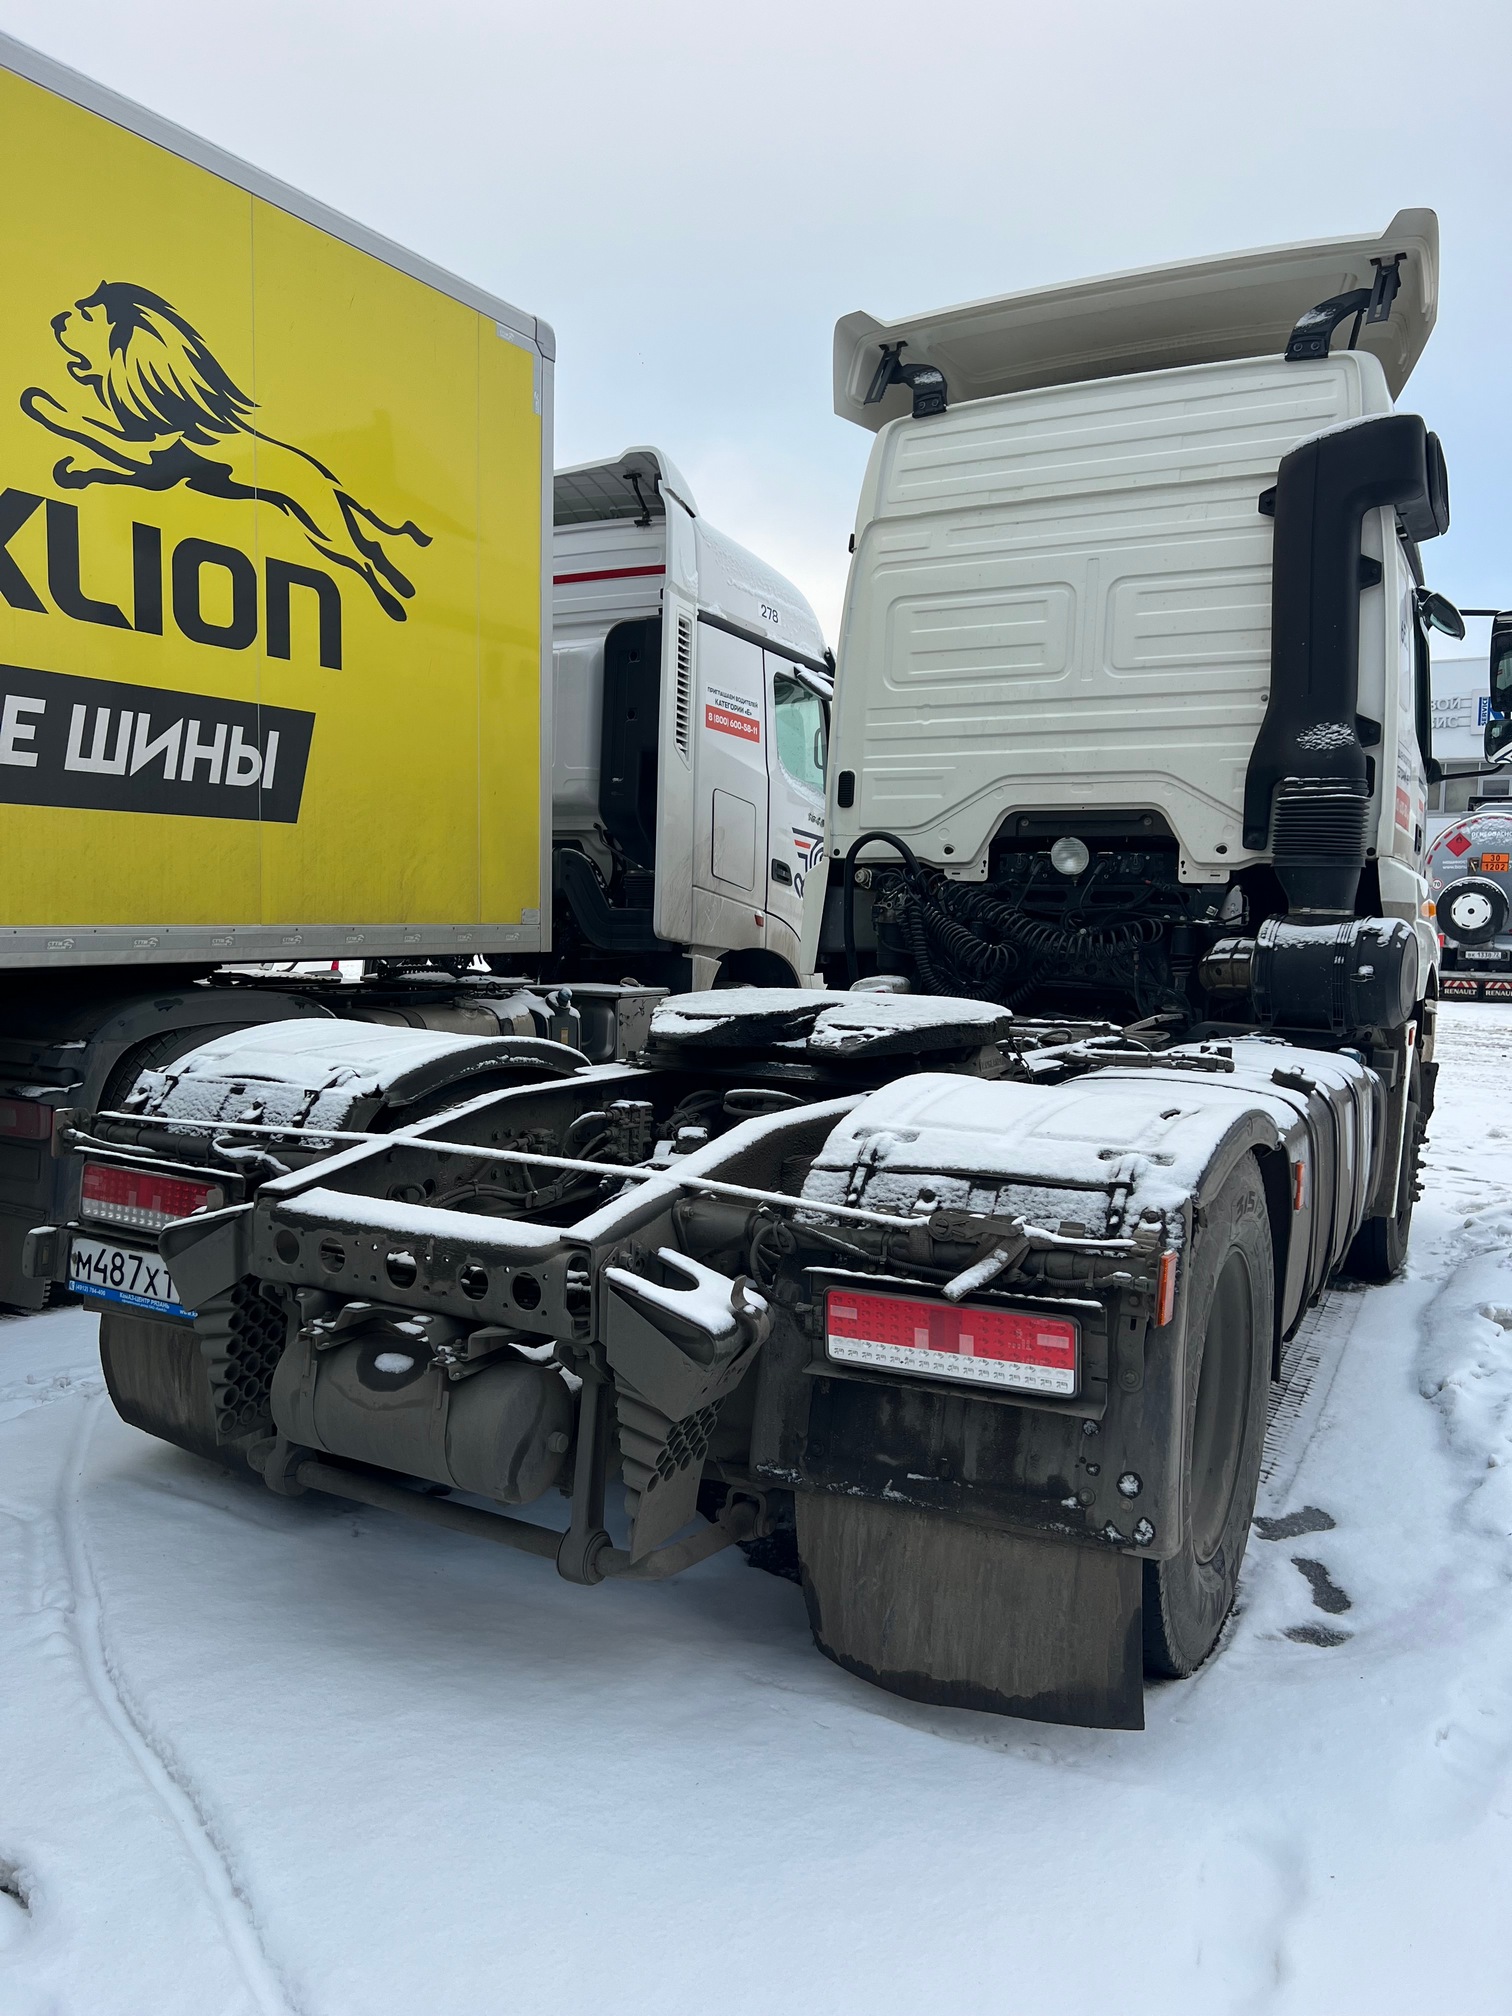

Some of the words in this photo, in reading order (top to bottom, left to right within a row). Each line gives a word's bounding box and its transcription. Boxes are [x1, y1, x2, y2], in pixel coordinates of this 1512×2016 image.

[761, 604, 779, 623] 278
[714, 698, 744, 714] КАТЕГОРИИ
[708, 712, 713, 721] 8
[713, 713, 729, 727] (800)
[729, 719, 758, 735] 600-58-11
[63, 703, 281, 790] ШИНЫ
[1490, 854, 1501, 862] 30
[1485, 863, 1505, 871] 1202
[1444, 988, 1478, 996] RENAULT
